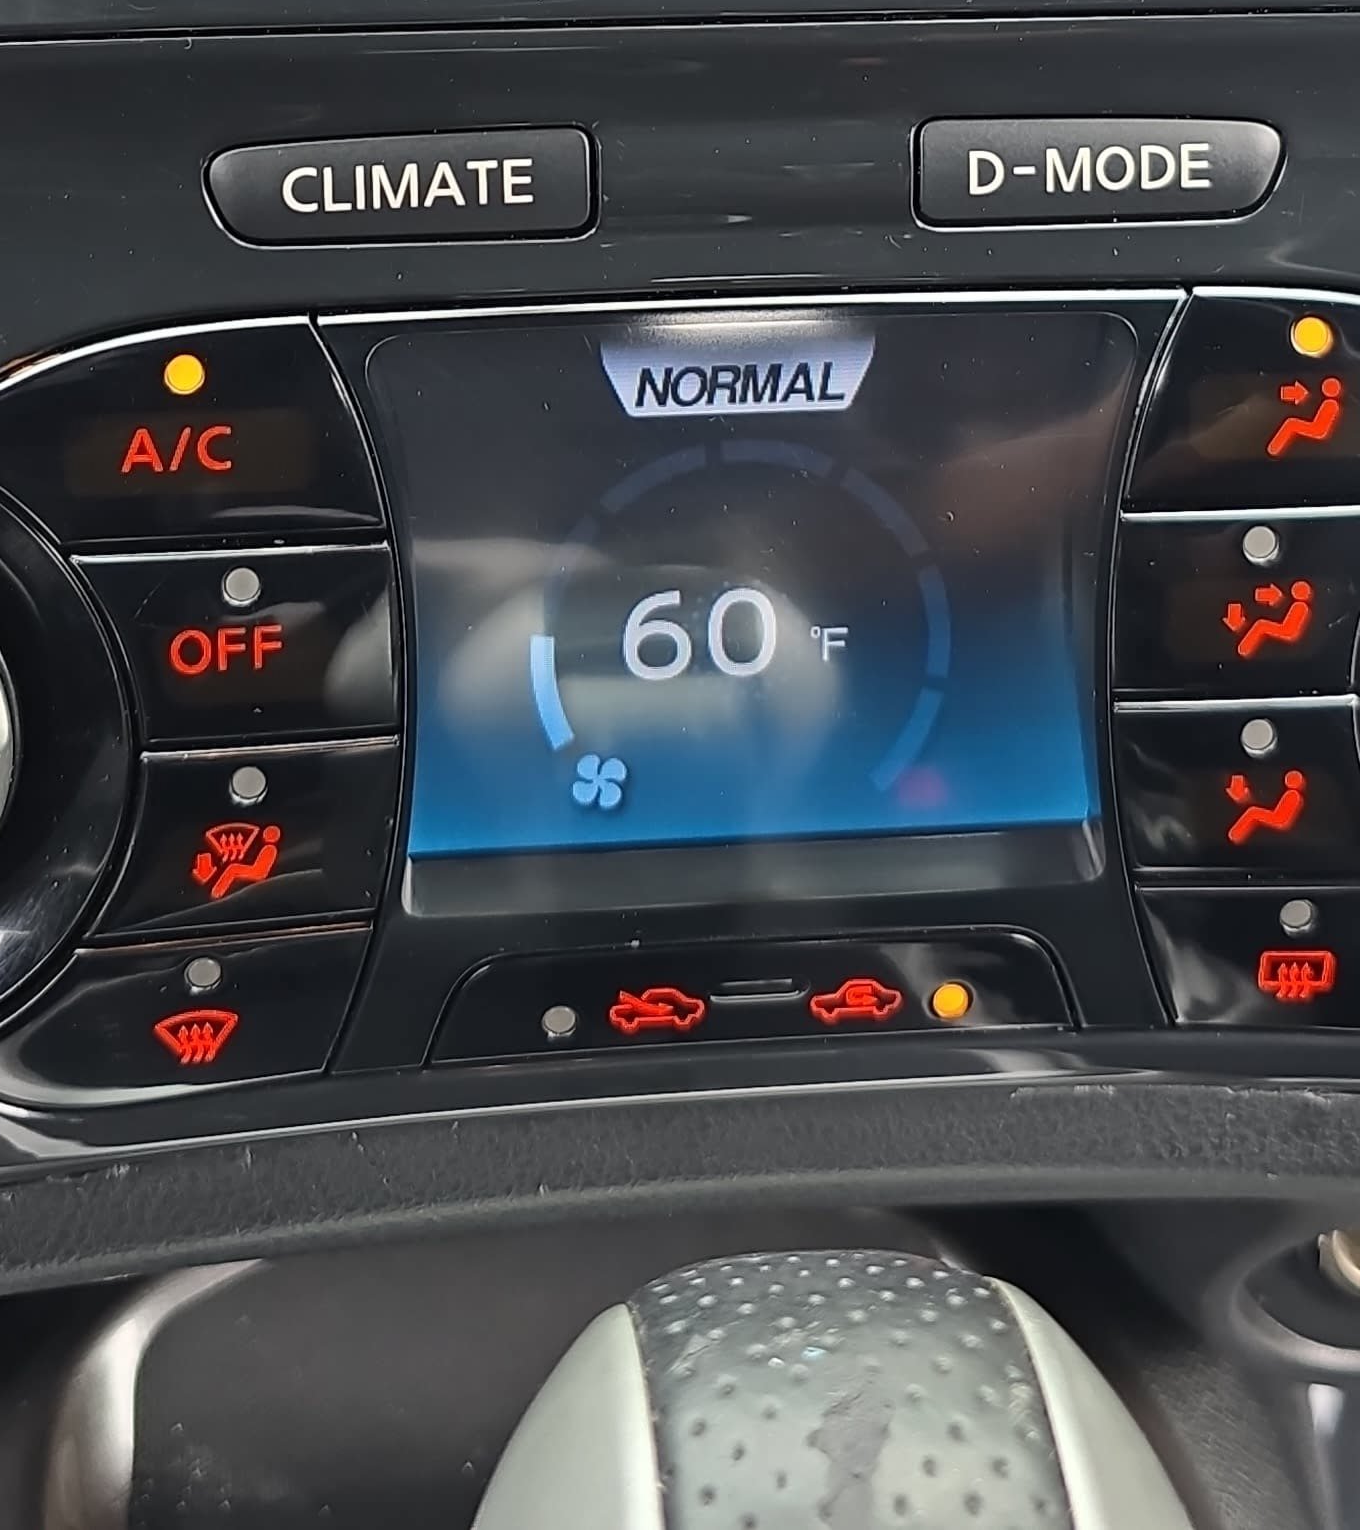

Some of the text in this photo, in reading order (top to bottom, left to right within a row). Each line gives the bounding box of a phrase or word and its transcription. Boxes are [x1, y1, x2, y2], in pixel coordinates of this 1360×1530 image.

[281, 157, 536, 214] CLIMATE
[967, 142, 1213, 196] D-MODE
[634, 361, 846, 409] NORMAL
[120, 425, 233, 474] A/C
[168, 623, 284, 676] OFF
[621, 586, 778, 682] 60
